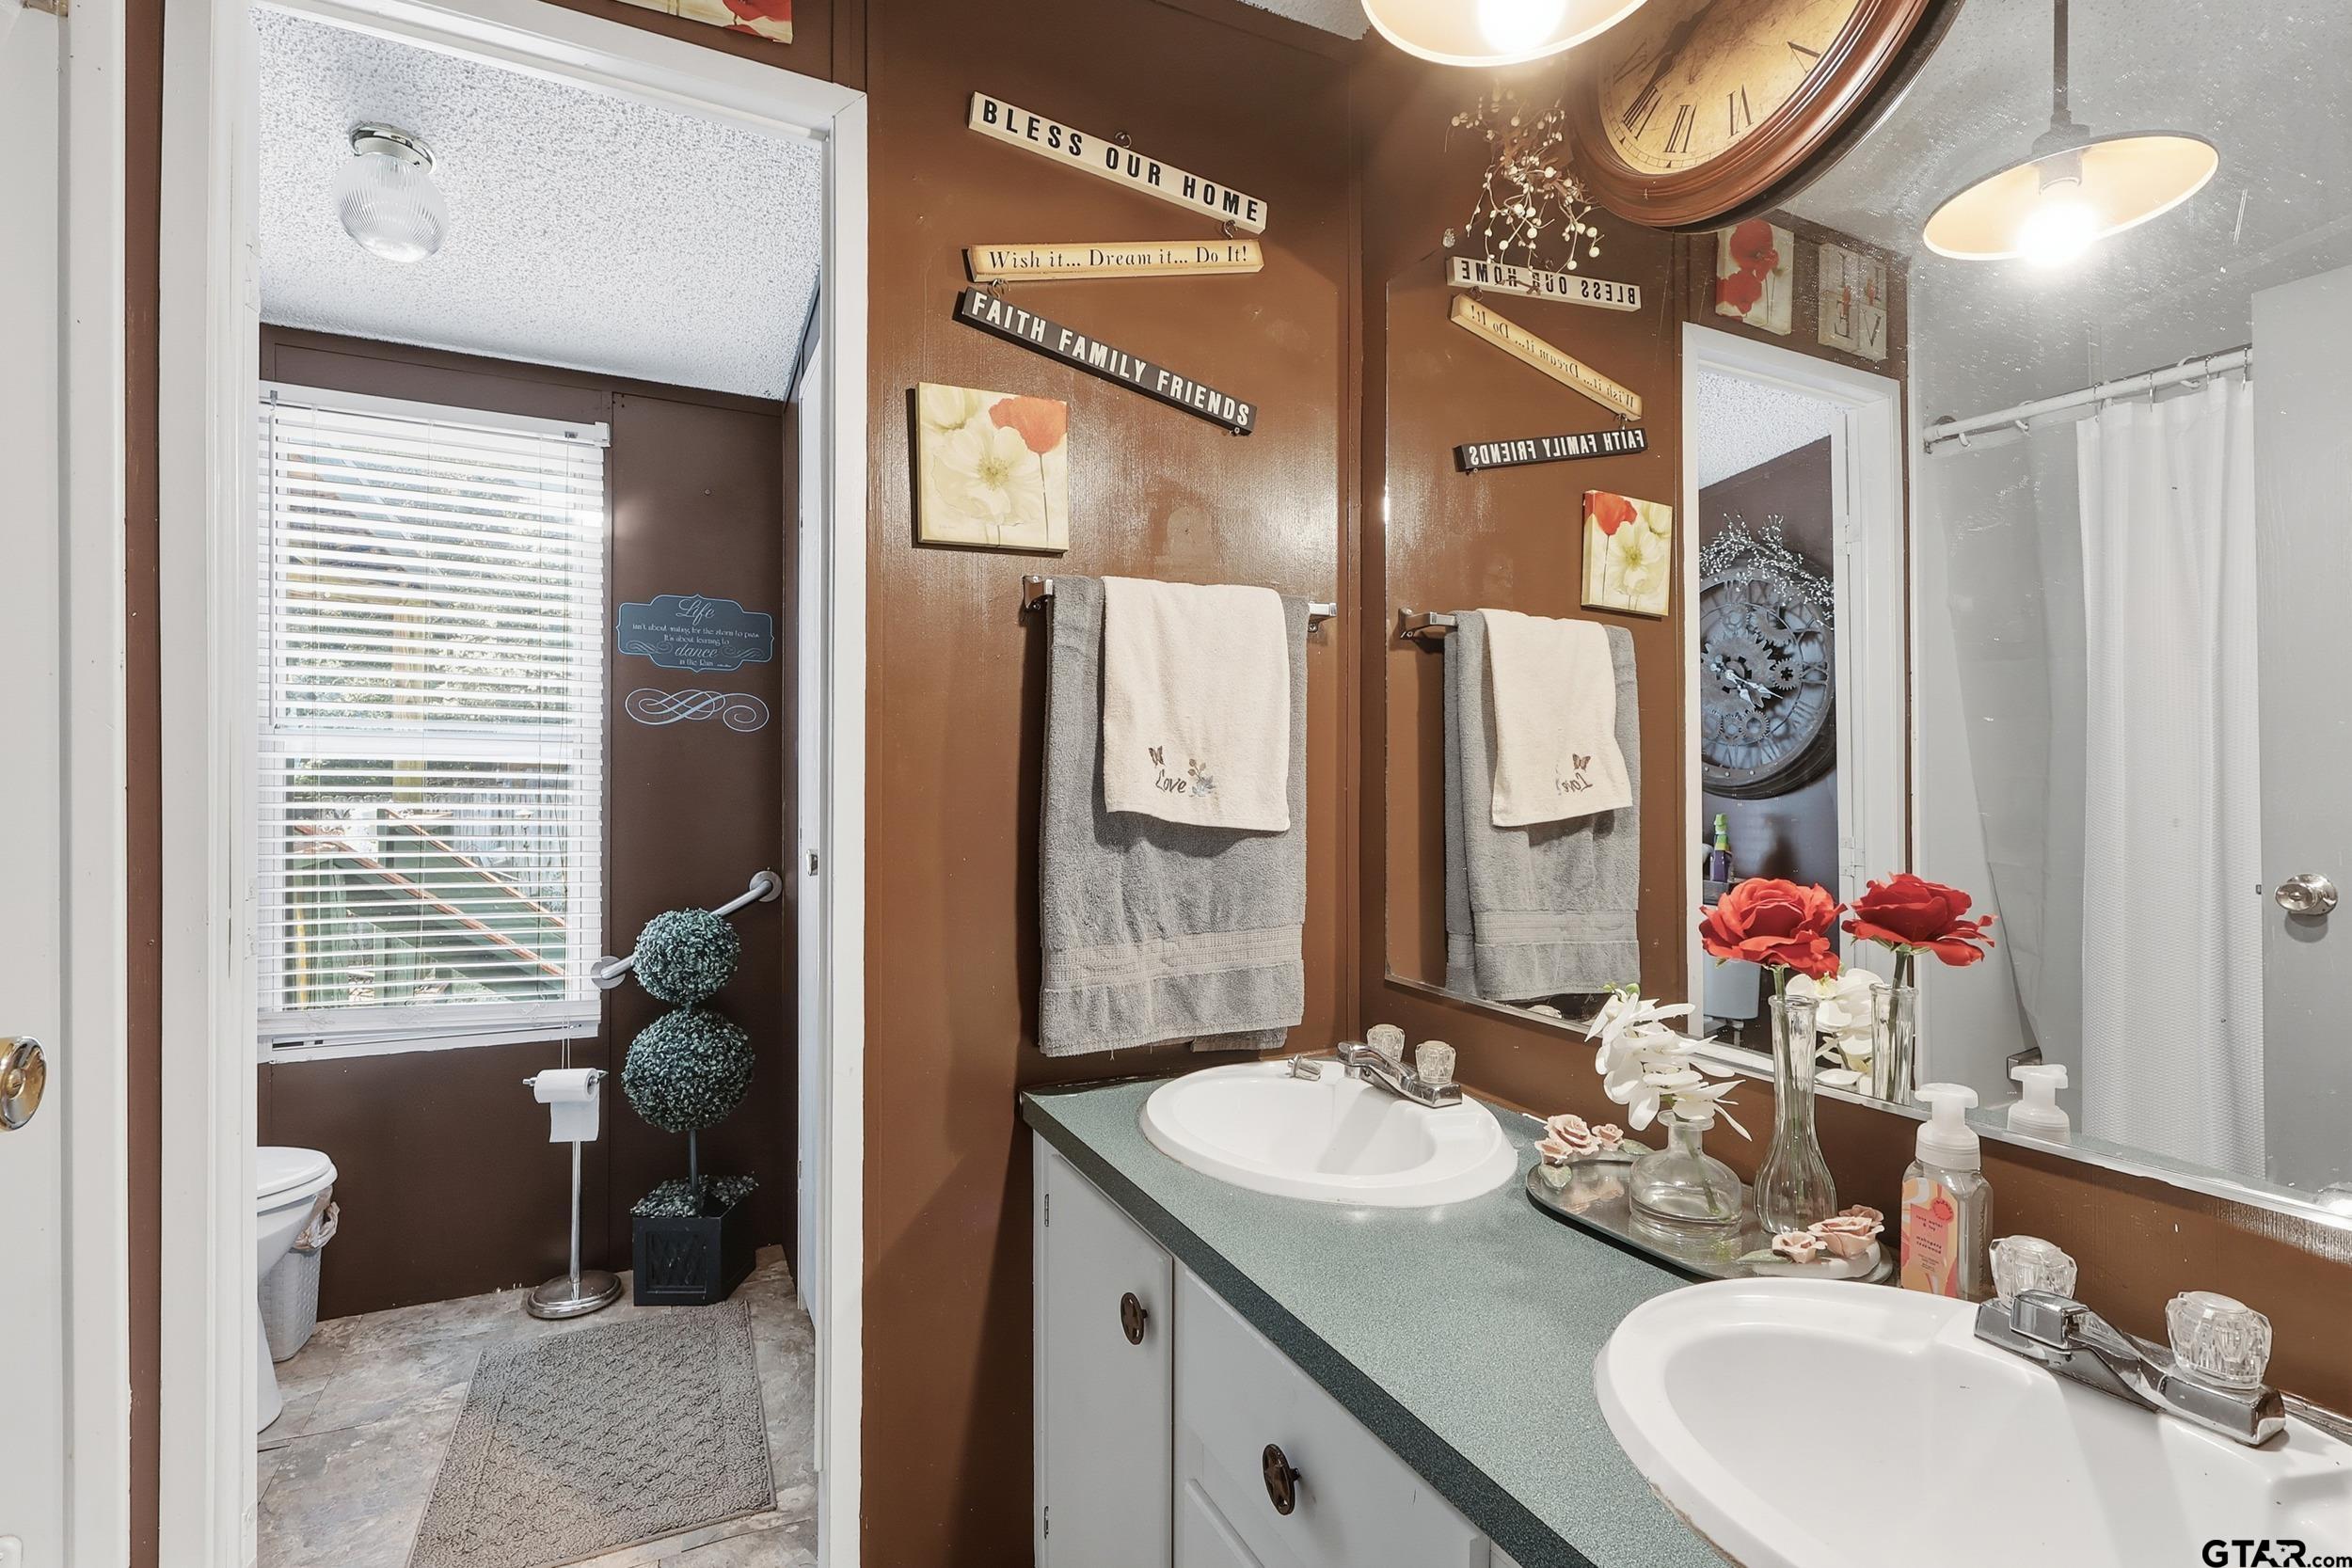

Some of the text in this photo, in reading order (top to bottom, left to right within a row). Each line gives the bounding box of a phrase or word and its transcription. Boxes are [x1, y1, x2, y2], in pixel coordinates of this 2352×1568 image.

[983, 100, 1258, 222] BLESS OUR HOME
[990, 245, 1248, 269] Wish it... Dream it... Do It!
[972, 292, 1249, 425] FAITH FAMILY FRIENDS
[675, 598, 715, 626] Life
[675, 642, 718, 657] dance
[1155, 768, 1186, 793] Love
